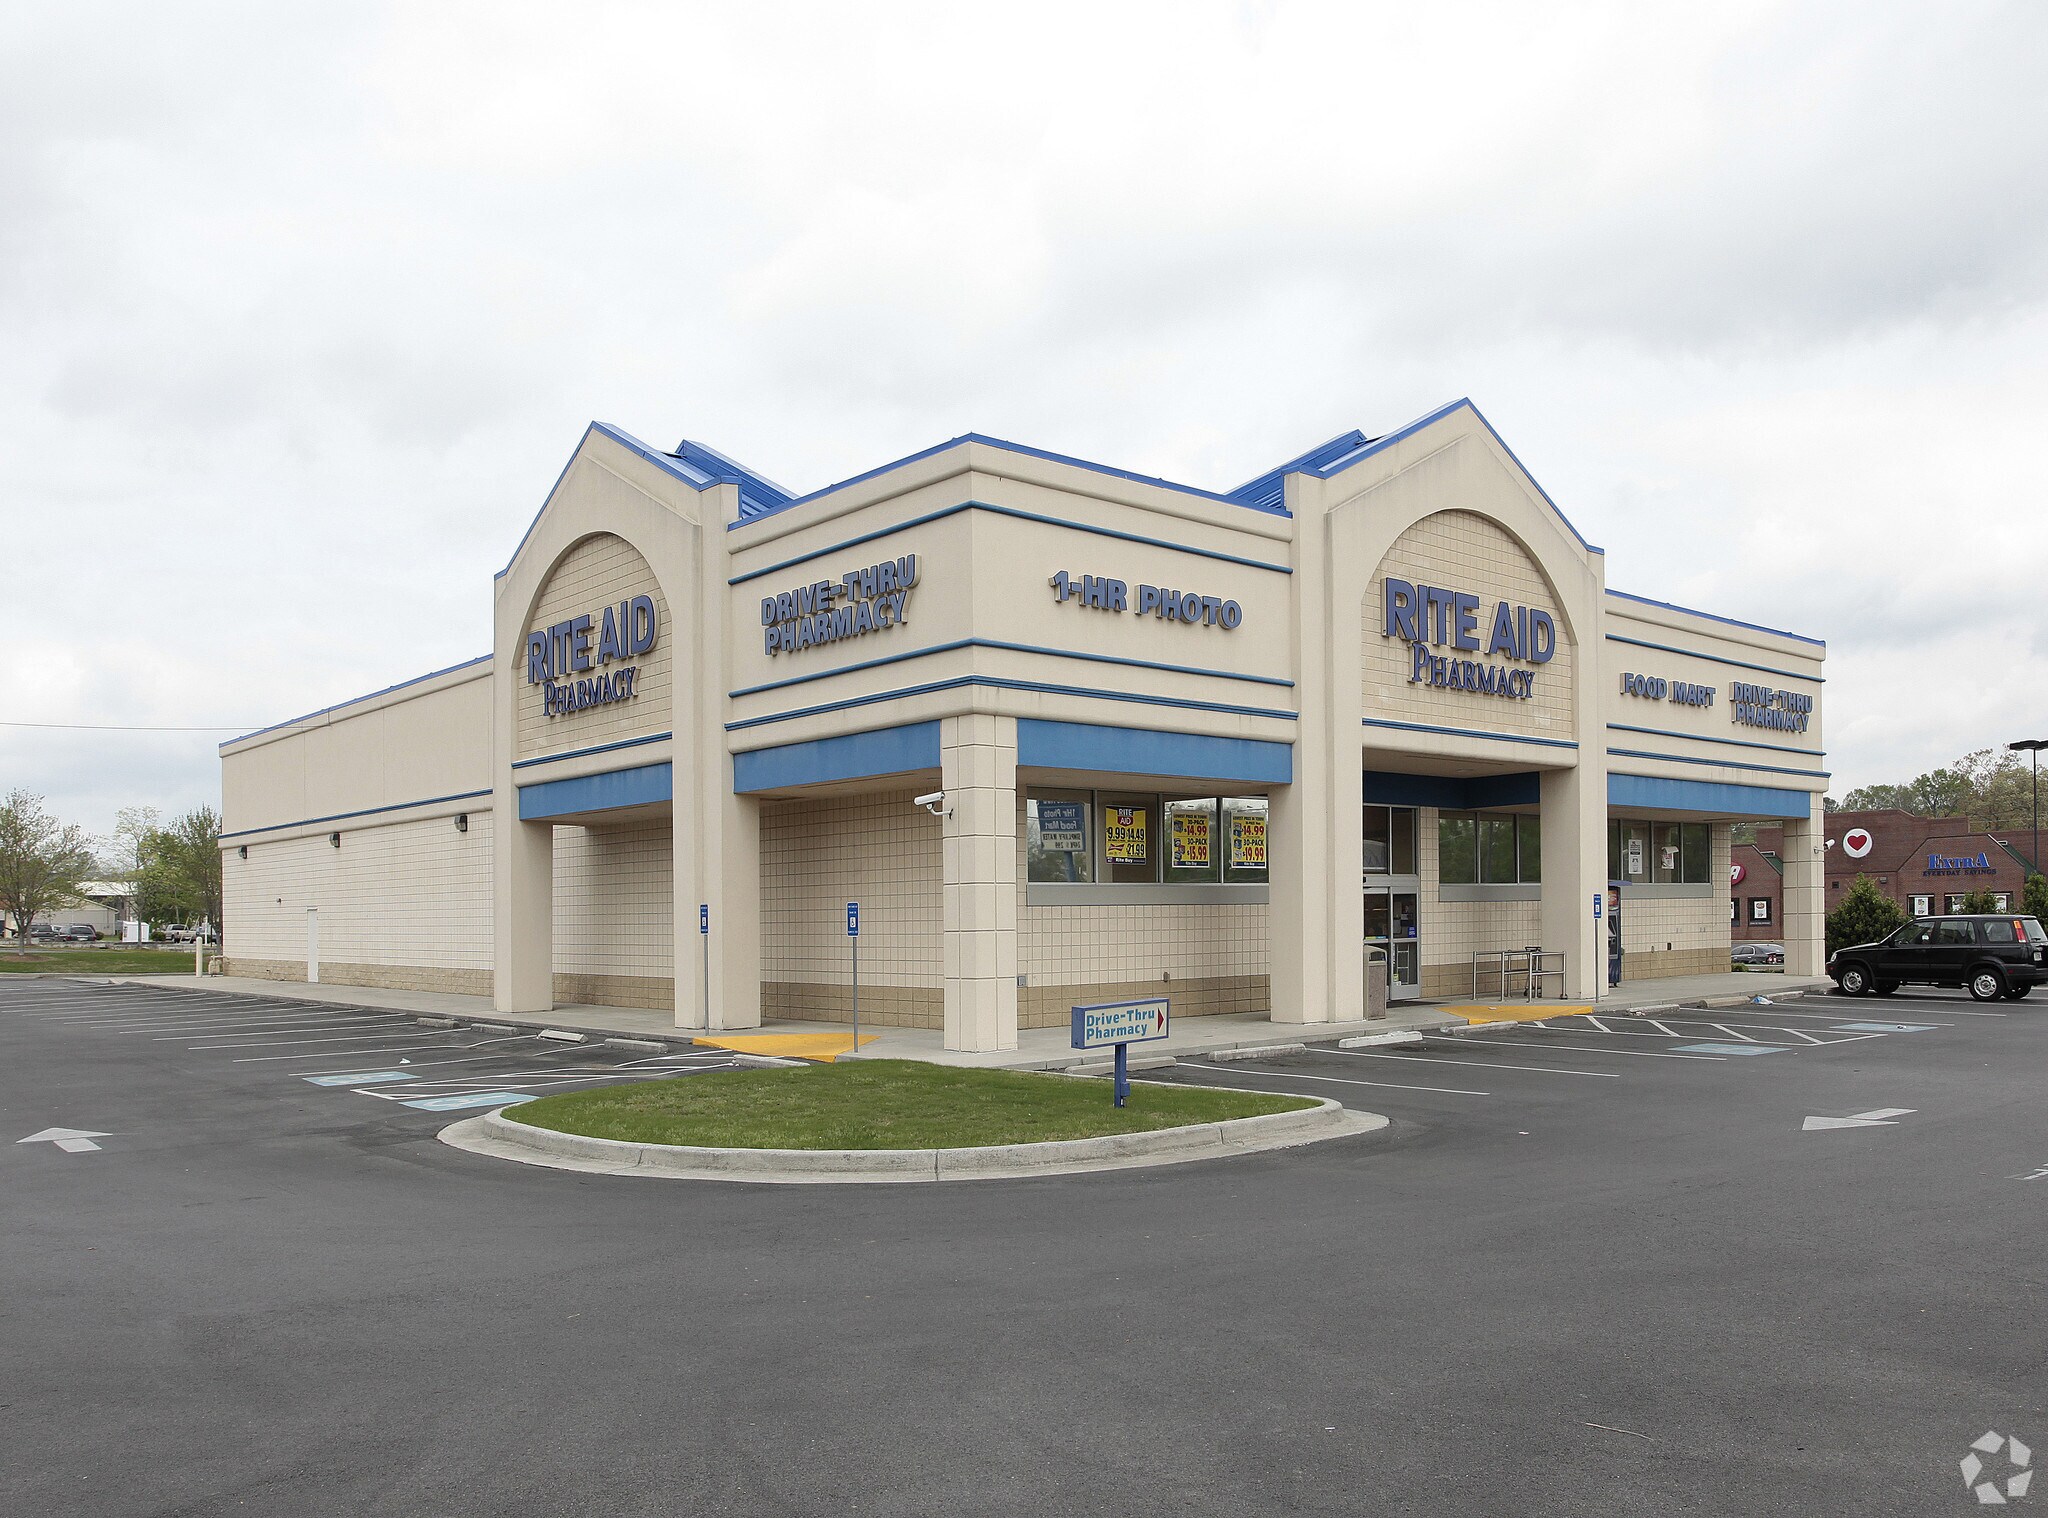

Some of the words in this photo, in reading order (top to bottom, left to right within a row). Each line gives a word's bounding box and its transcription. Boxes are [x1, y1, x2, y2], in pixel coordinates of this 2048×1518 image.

[761, 553, 918, 626] DRIVE-THRU
[1050, 570, 1128, 611] 1-HR
[1135, 584, 1243, 629] PHOTO
[764, 590, 911, 656] PHARMACY
[1383, 577, 1480, 651] RITE
[1487, 601, 1556, 664] AID
[527, 613, 593, 684] RITE
[597, 595, 657, 665] AID
[1621, 672, 1668, 700] FOOD
[1669, 681, 1716, 707] MART
[1730, 682, 1813, 714] DRIVE-THRU
[1732, 703, 1810, 733] PHARMACY
[1118, 808, 1134, 816] RITE
[1119, 817, 1132, 825] AID
[1964, 868, 1997, 876] SAVINGS
[1086, 1009, 1155, 1027] Drive-Thru
[1086, 1024, 1148, 1041] Pharmacy
